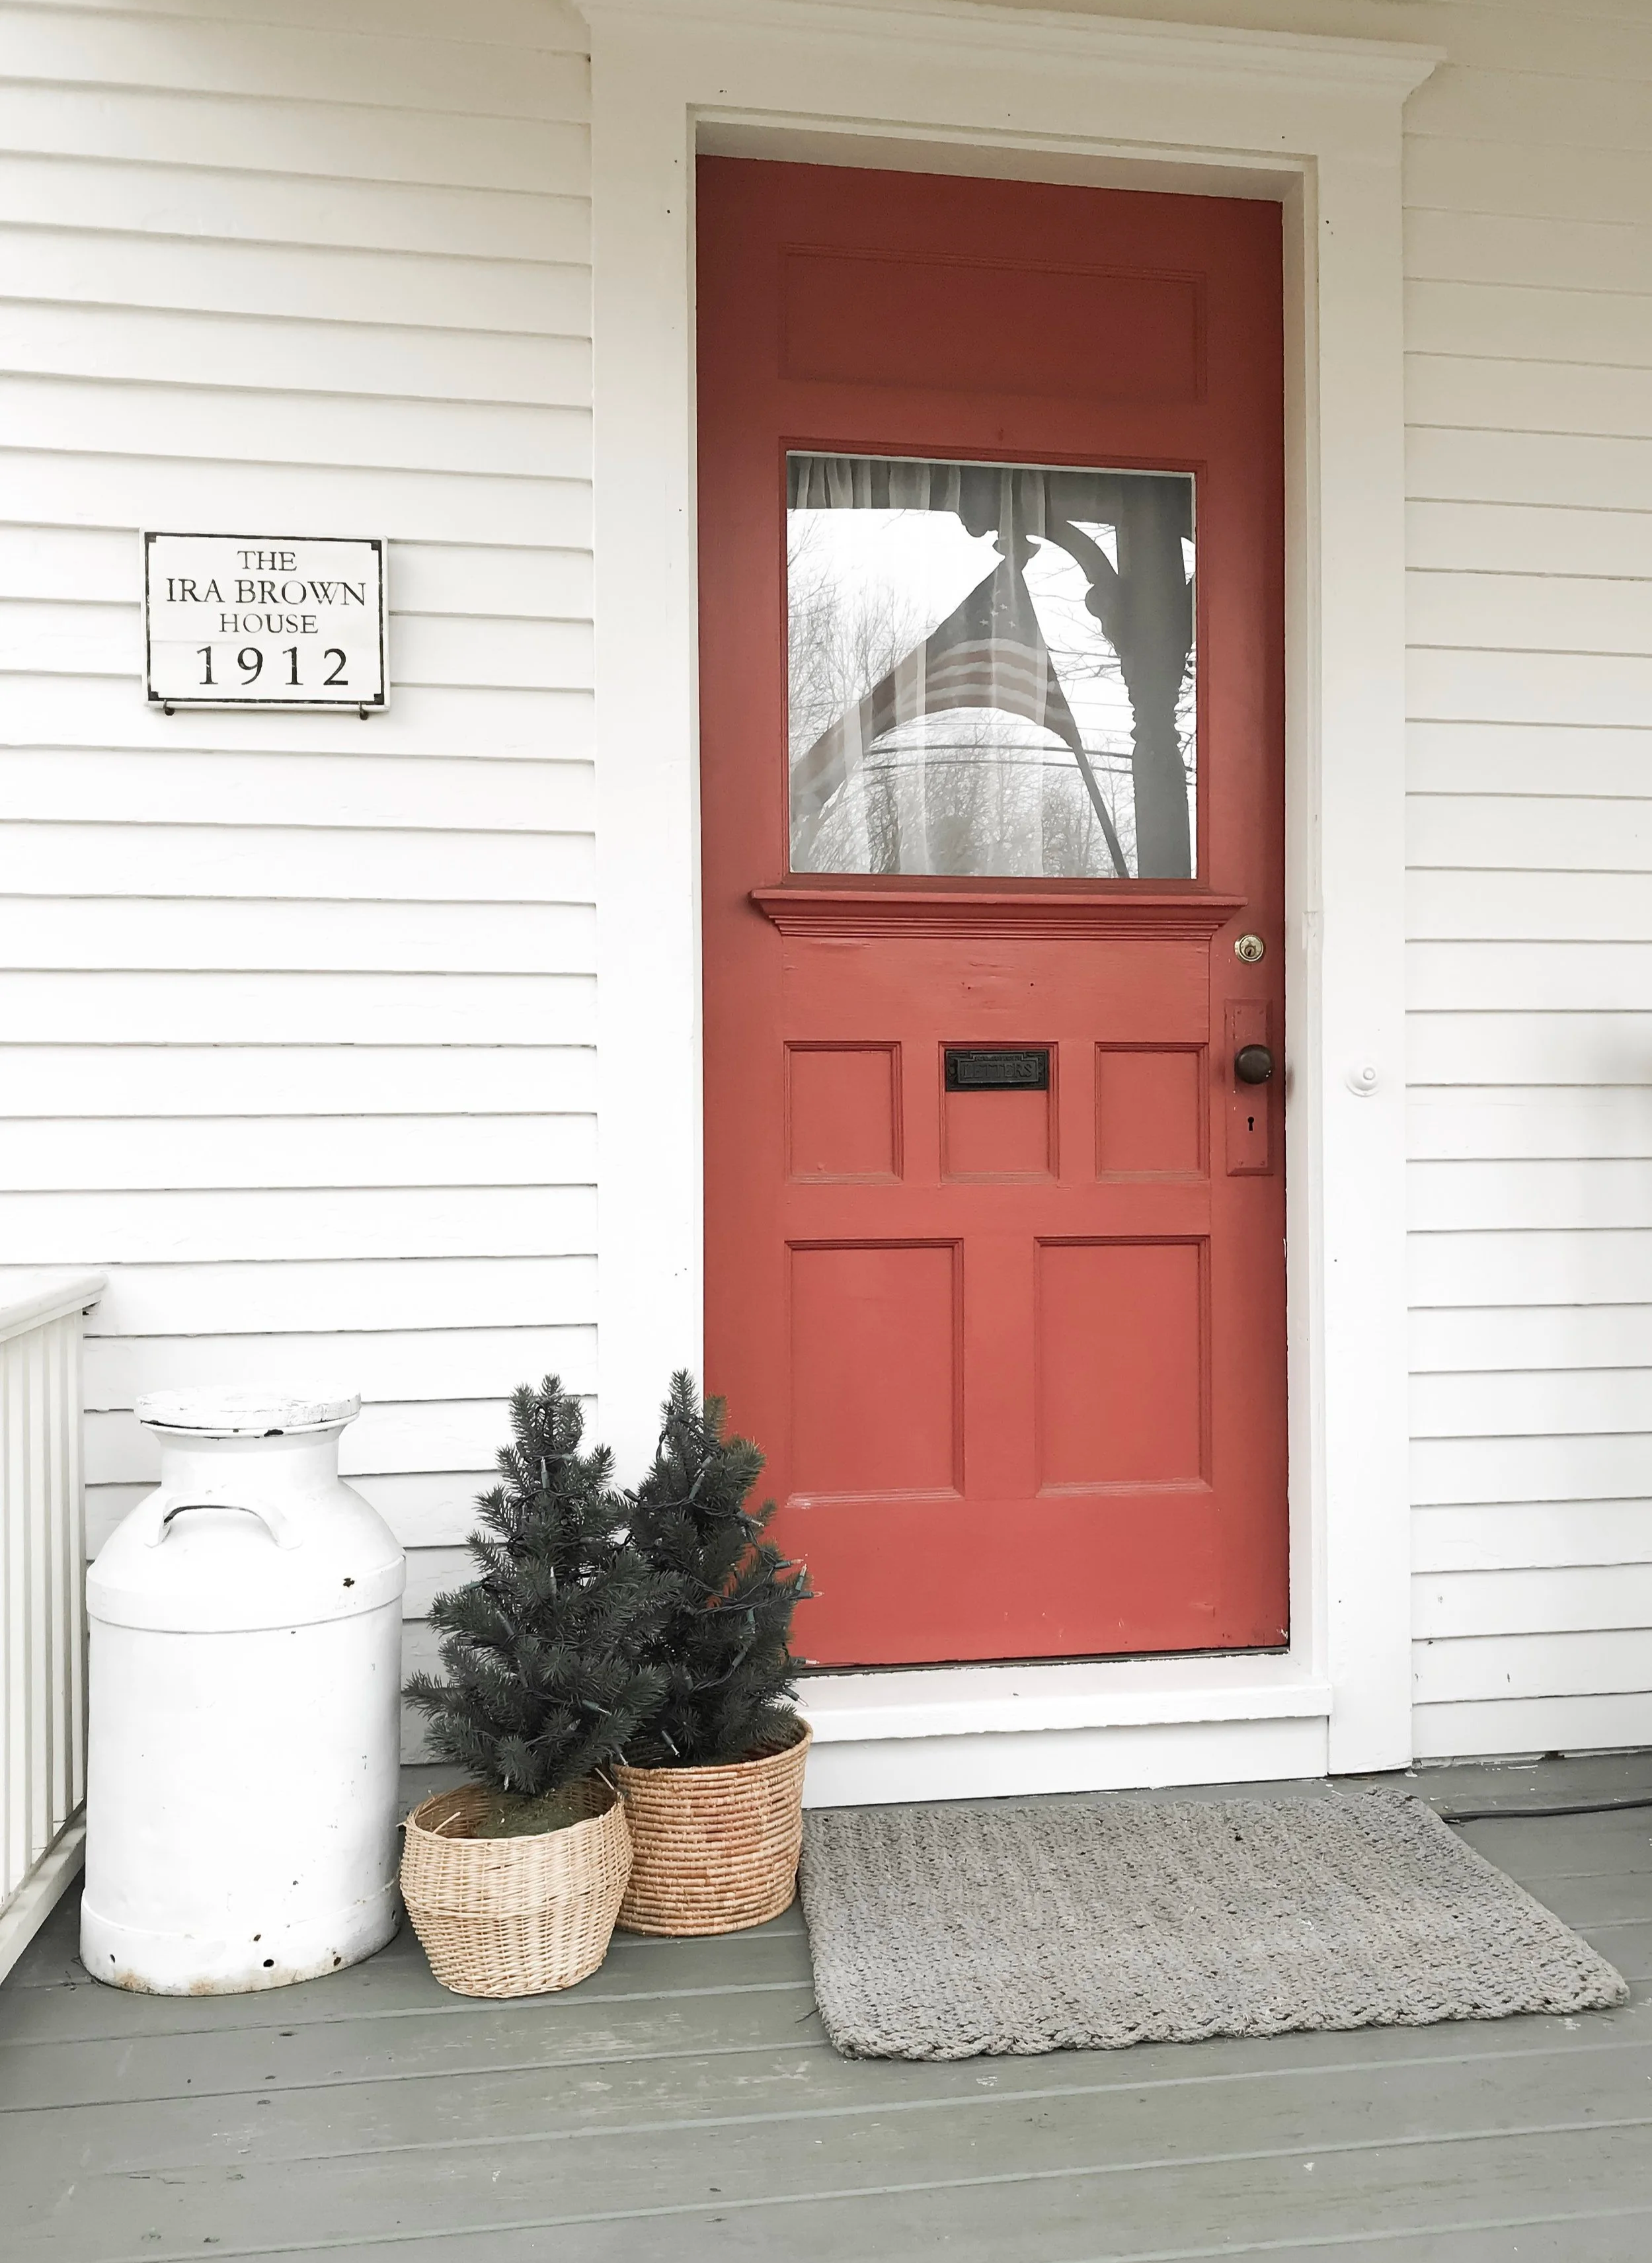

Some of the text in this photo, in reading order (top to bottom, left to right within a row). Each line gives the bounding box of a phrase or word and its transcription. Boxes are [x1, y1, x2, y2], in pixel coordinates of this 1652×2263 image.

[237, 551, 297, 571] THE
[167, 578, 366, 606] IRA BROWN
[219, 614, 318, 633] HOUSE
[197, 646, 348, 686] 1912
[963, 1063, 1033, 1078] LETTERS
